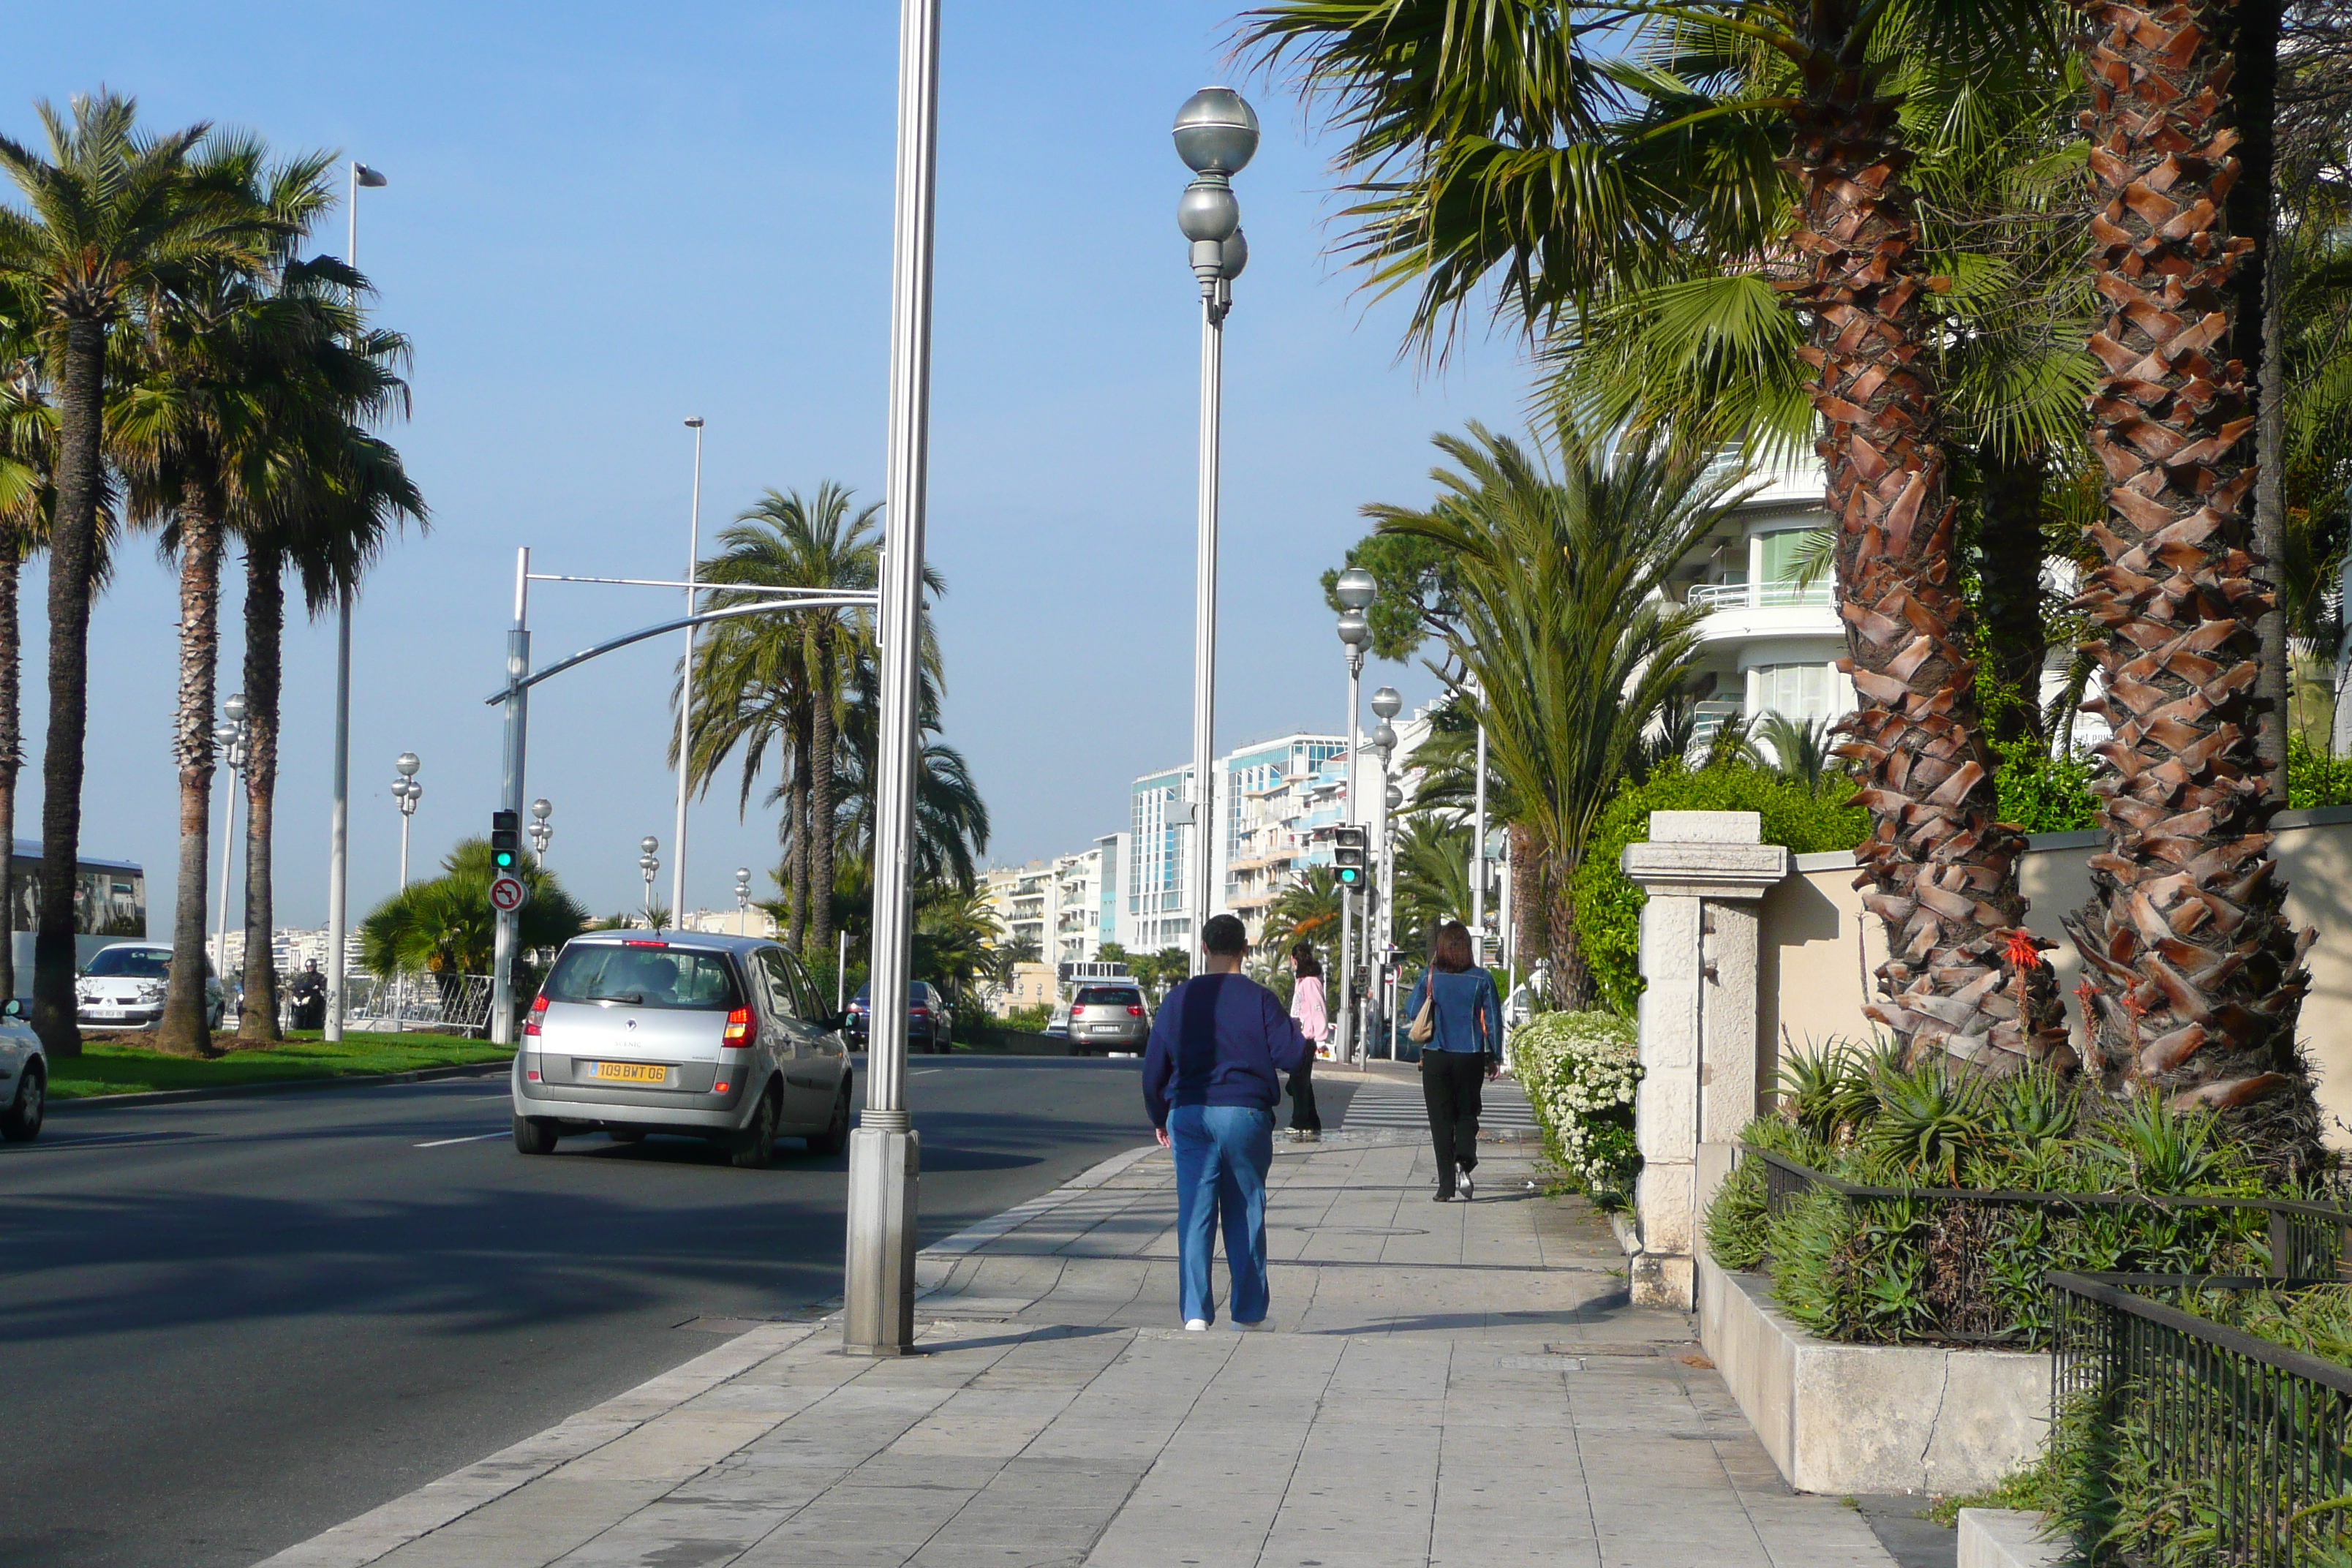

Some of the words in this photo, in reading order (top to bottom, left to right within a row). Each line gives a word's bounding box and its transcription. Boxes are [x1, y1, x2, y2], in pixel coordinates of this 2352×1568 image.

[600, 1064, 621, 1077] 109
[623, 1065, 646, 1079] BWT
[648, 1067, 664, 1080] 06
